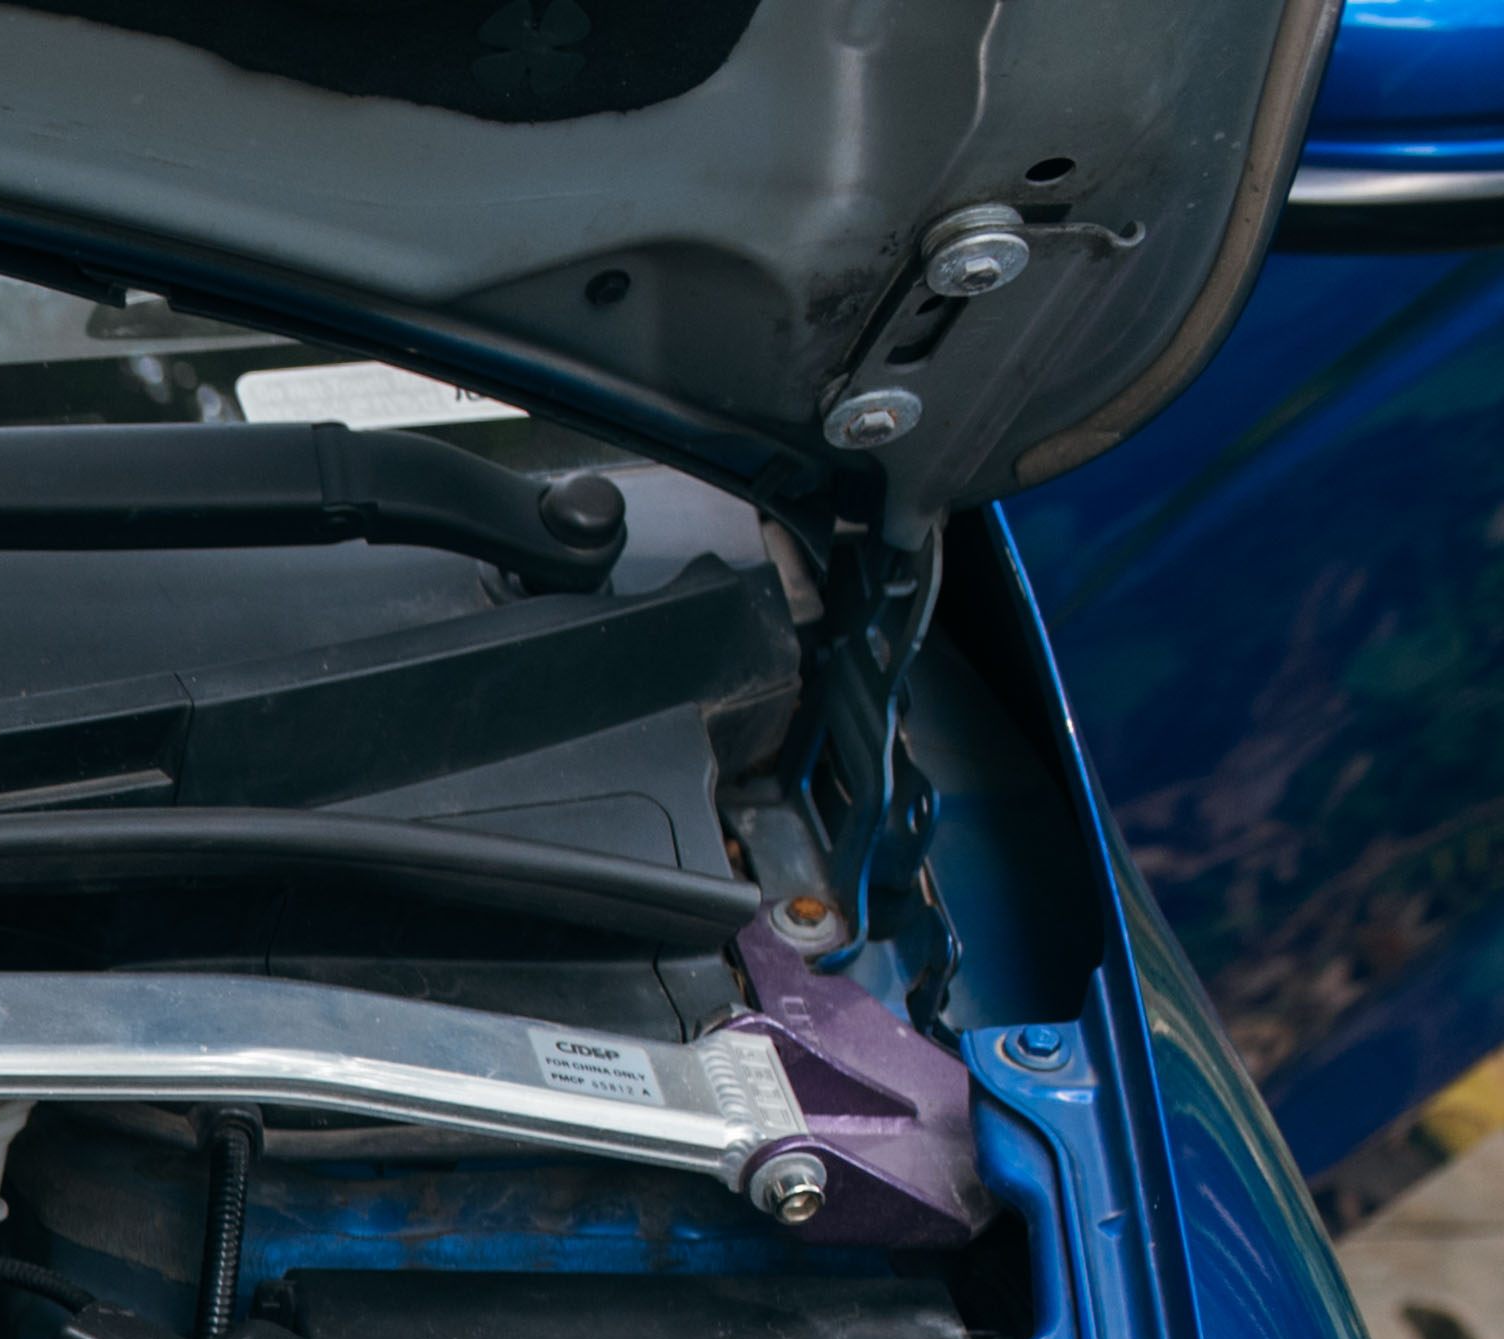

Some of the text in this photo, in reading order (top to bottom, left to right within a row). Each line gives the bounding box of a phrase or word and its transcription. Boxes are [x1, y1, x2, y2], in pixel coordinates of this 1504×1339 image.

[545, 1057, 645, 1081] FOR CHINA ONLY
